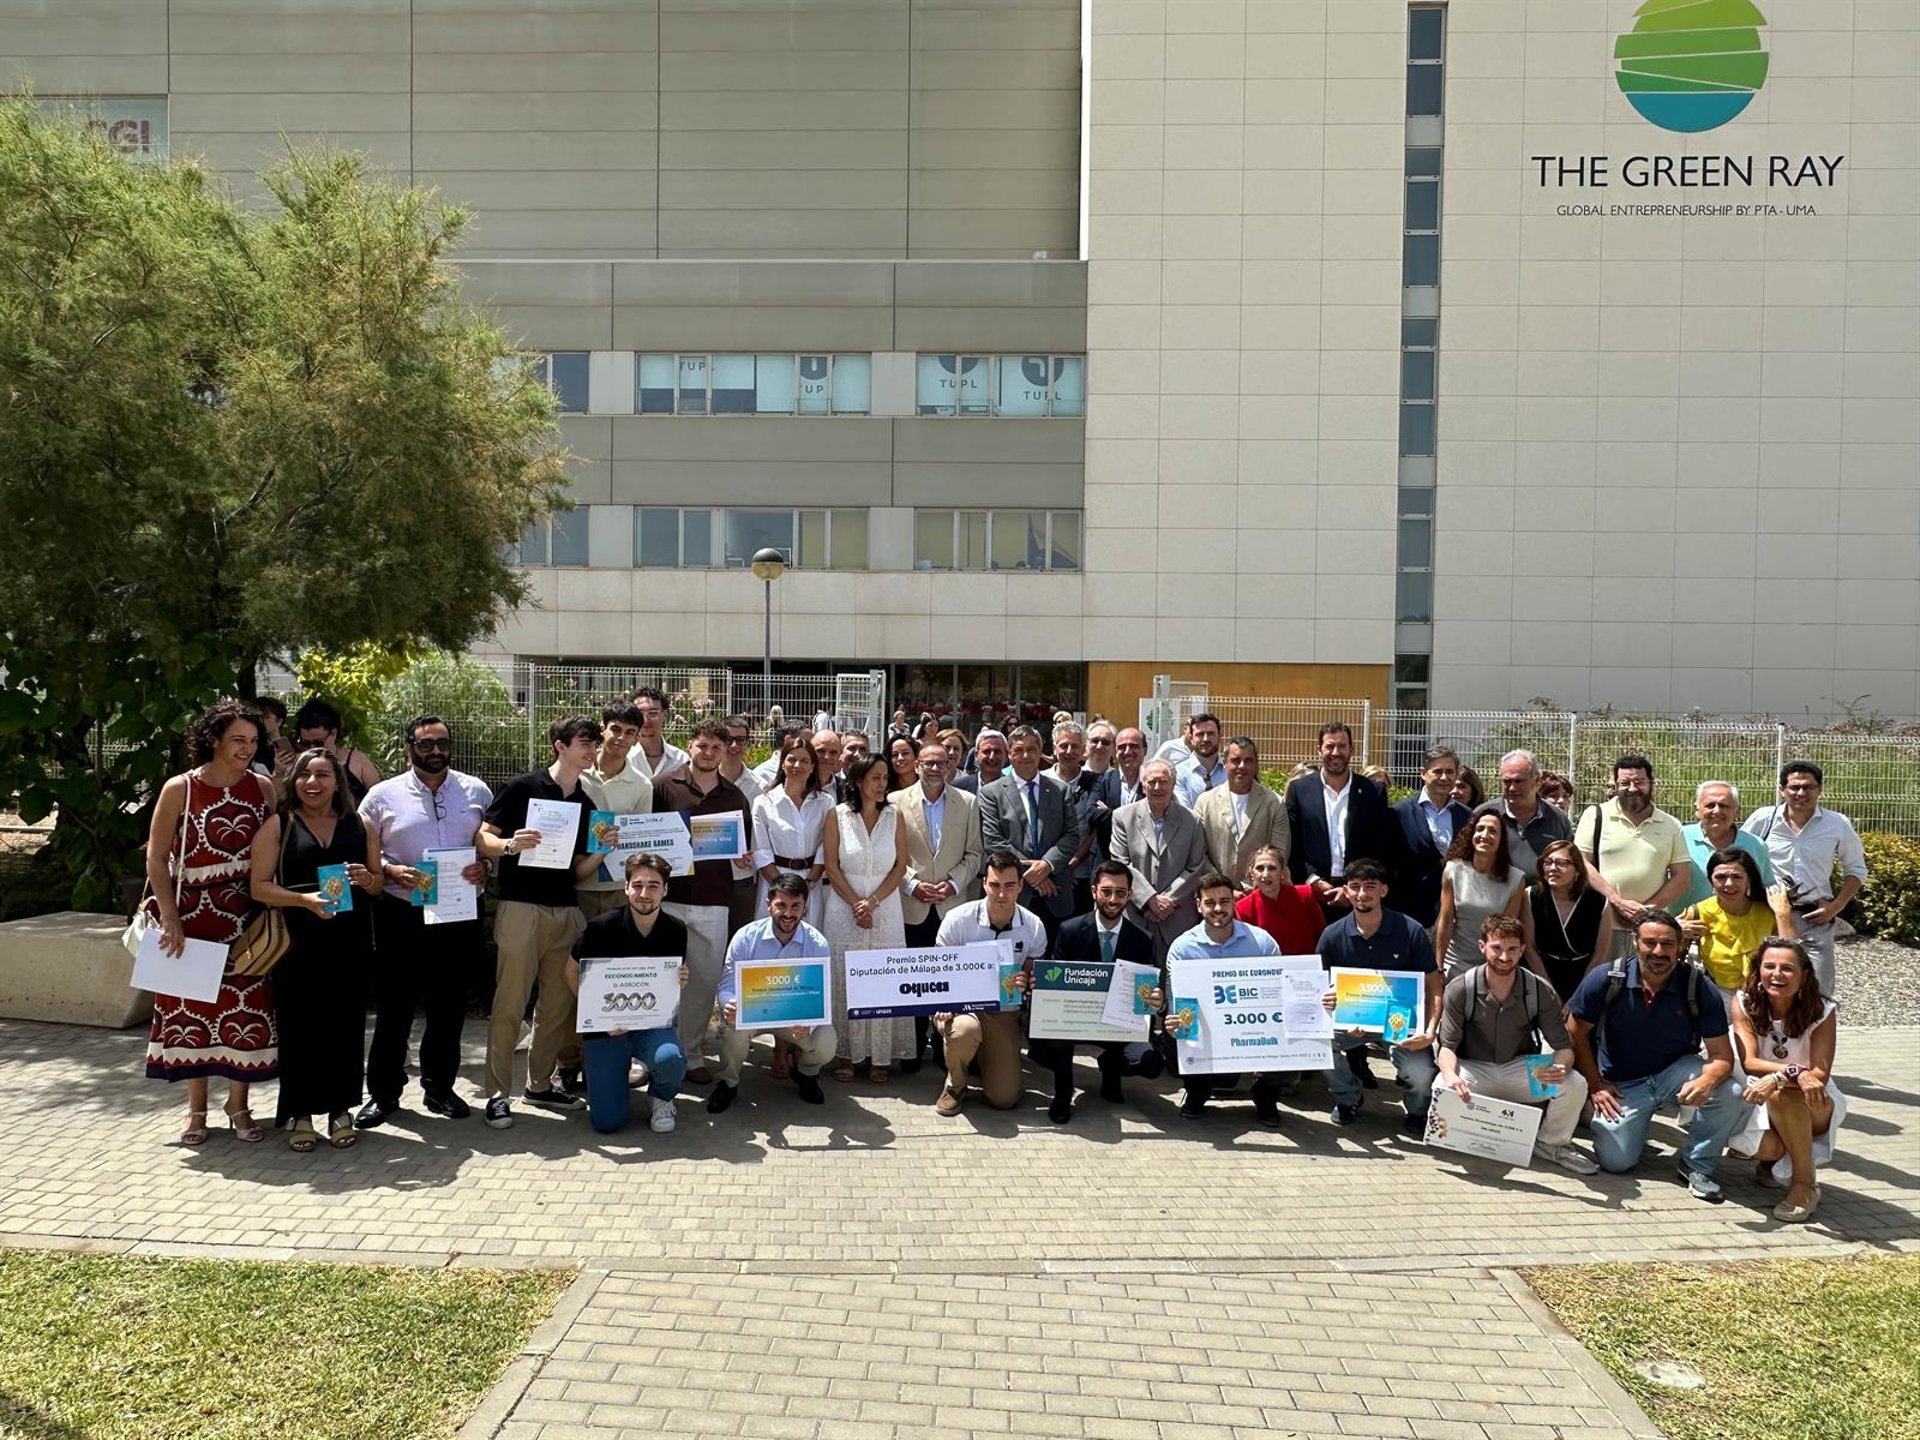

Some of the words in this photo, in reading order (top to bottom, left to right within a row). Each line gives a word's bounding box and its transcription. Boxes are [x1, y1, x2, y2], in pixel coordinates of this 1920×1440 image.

[1531, 156, 1608, 187] THE
[1622, 156, 1753, 187] GREEN
[1769, 156, 1845, 187] RAY
[1556, 204, 1606, 217] GLOBAL
[1611, 204, 1733, 216] ENTREPRENEURSHIP
[1736, 204, 1750, 216] BY
[1754, 204, 1776, 216] PTA
[1786, 204, 1816, 216] UMA
[939, 379, 978, 389] TUPL
[653, 838, 674, 847] GAMES
[886, 955, 916, 965] Premio
[918, 953, 959, 963] SPIN-OFF
[850, 966, 896, 977] Diputación
[897, 965, 908, 974] de
[910, 964, 941, 974] Málaga
[955, 962, 985, 971] 3.000€
[1064, 967, 1109, 978] Fundación
[1212, 970, 1237, 978] PREMIO
[766, 975, 791, 985] 3000
[794, 974, 801, 984] €
[1064, 975, 1096, 987] Unicaja
[1239, 988, 1258, 997] BIC
[601, 992, 656, 1012] 3000
[1224, 1013, 1267, 1025] 3.000
[1271, 1012, 1284, 1023] €
[1231, 1037, 1279, 1047] PharmaBulk
